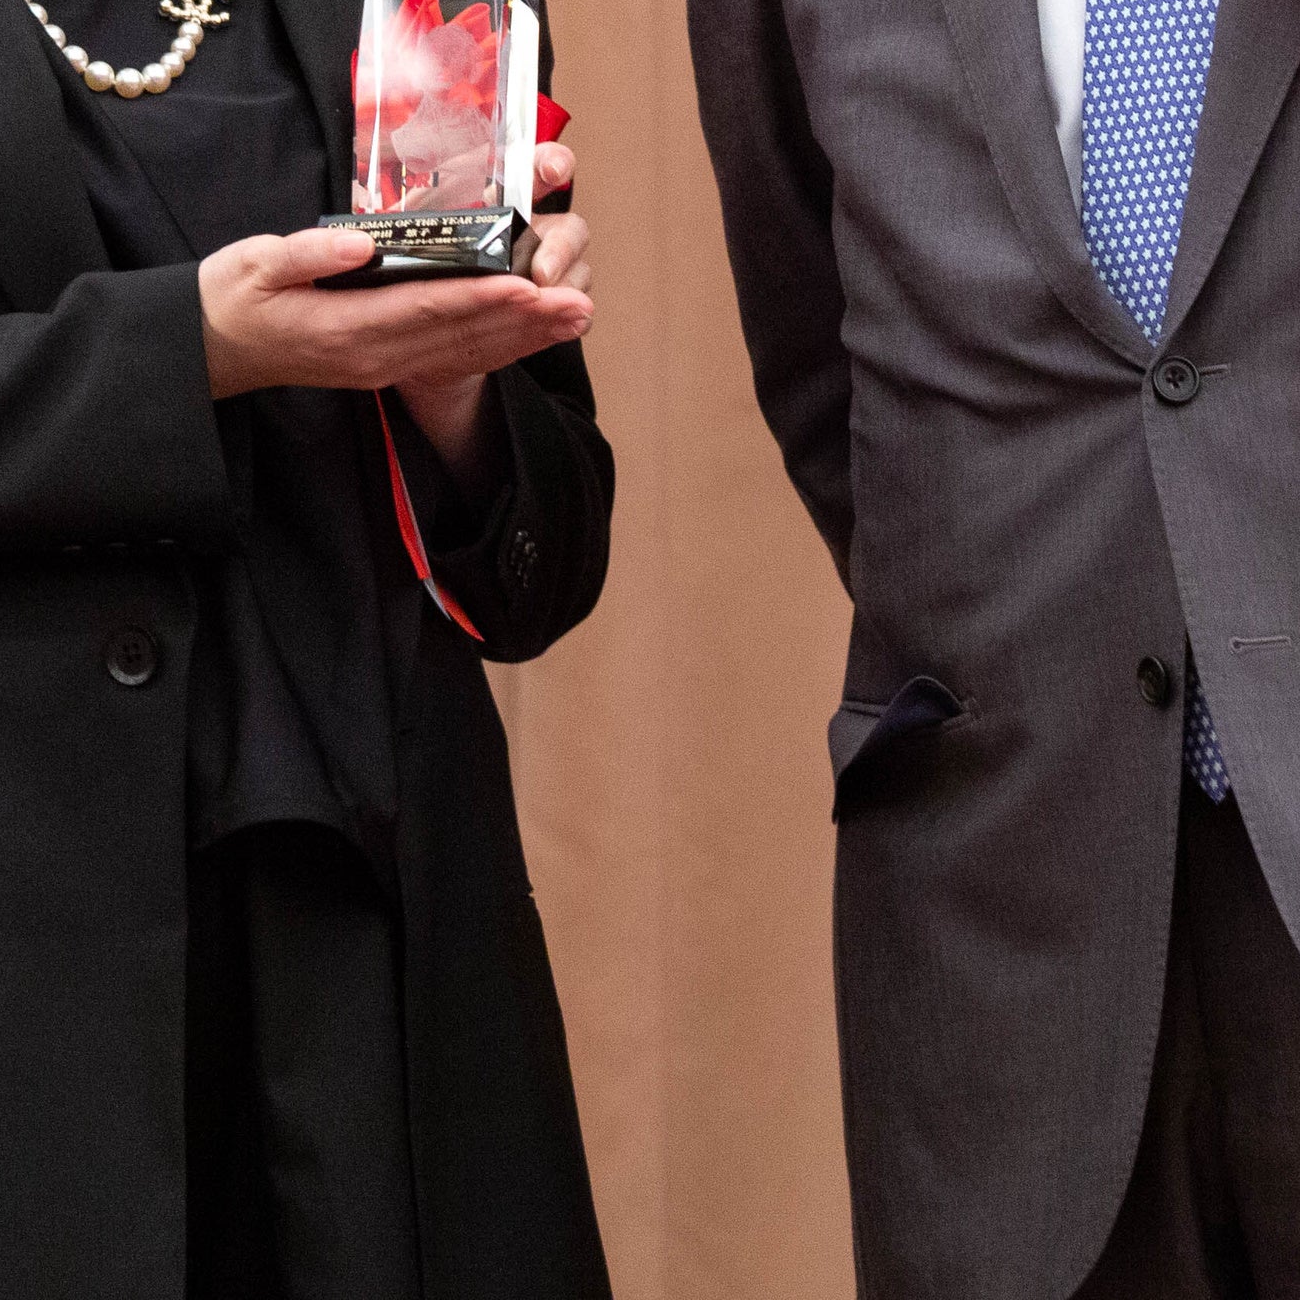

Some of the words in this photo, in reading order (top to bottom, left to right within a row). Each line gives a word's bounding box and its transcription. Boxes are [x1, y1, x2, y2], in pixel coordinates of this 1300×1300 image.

[394, 219, 414, 228] OF
[415, 217, 440, 227] THE
[442, 216, 473, 226] YEAR
